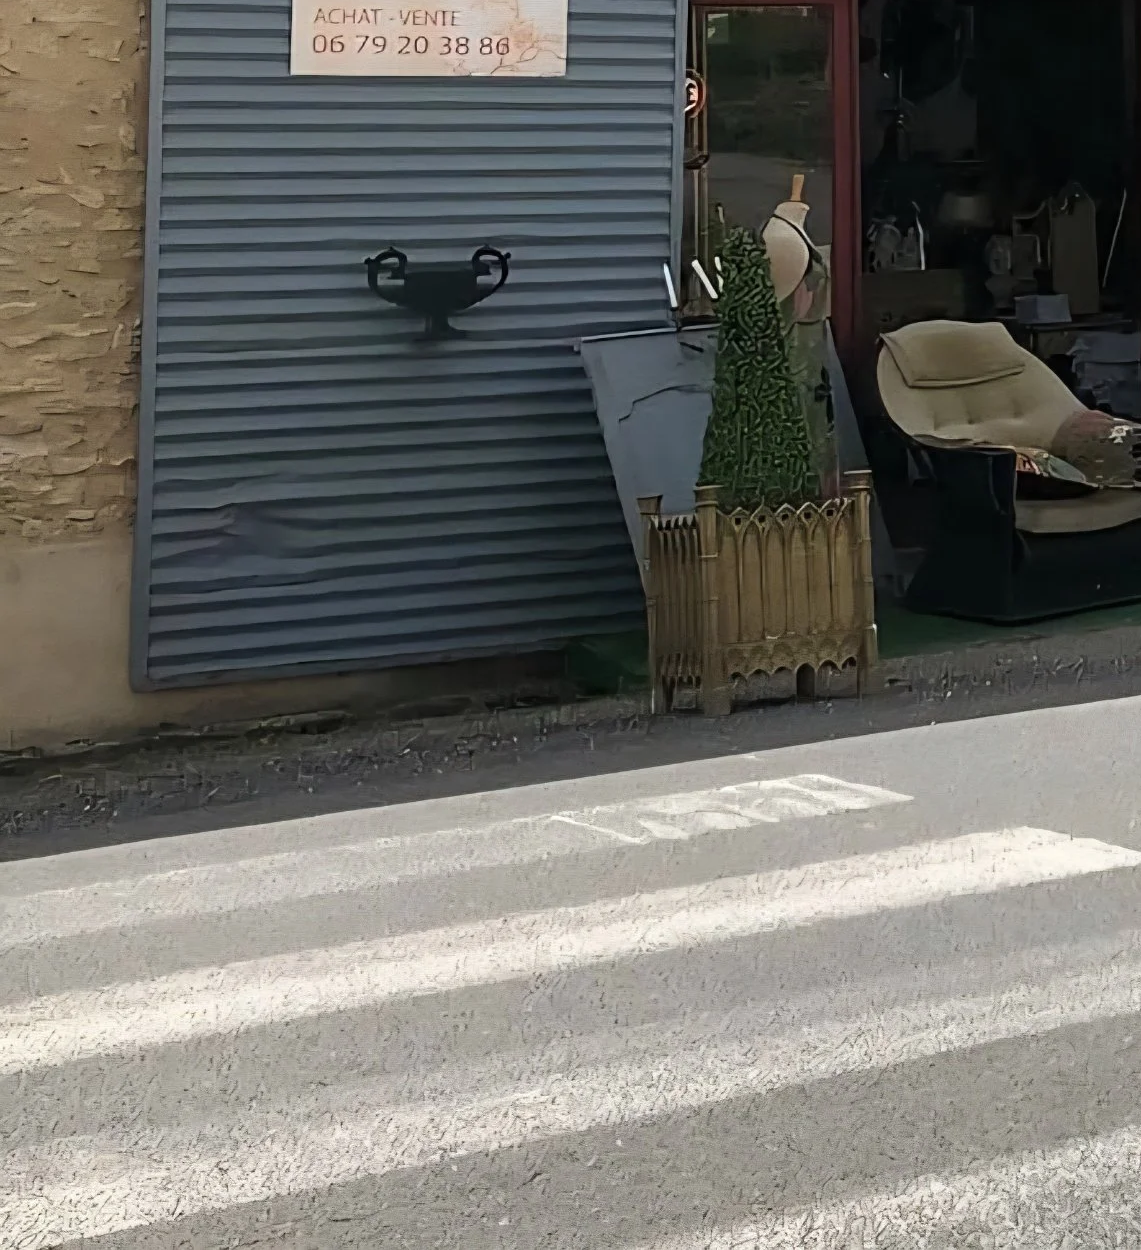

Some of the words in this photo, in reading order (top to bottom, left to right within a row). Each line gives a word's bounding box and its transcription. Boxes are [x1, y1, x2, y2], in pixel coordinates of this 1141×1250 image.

[314, 8, 383, 25] ACHAT
[399, 9, 462, 26] VENTE
[312, 34, 345, 54] 06
[355, 35, 387, 55] 79
[397, 35, 429, 55] 20
[439, 36, 470, 56] 38
[479, 36, 511, 56] 86
